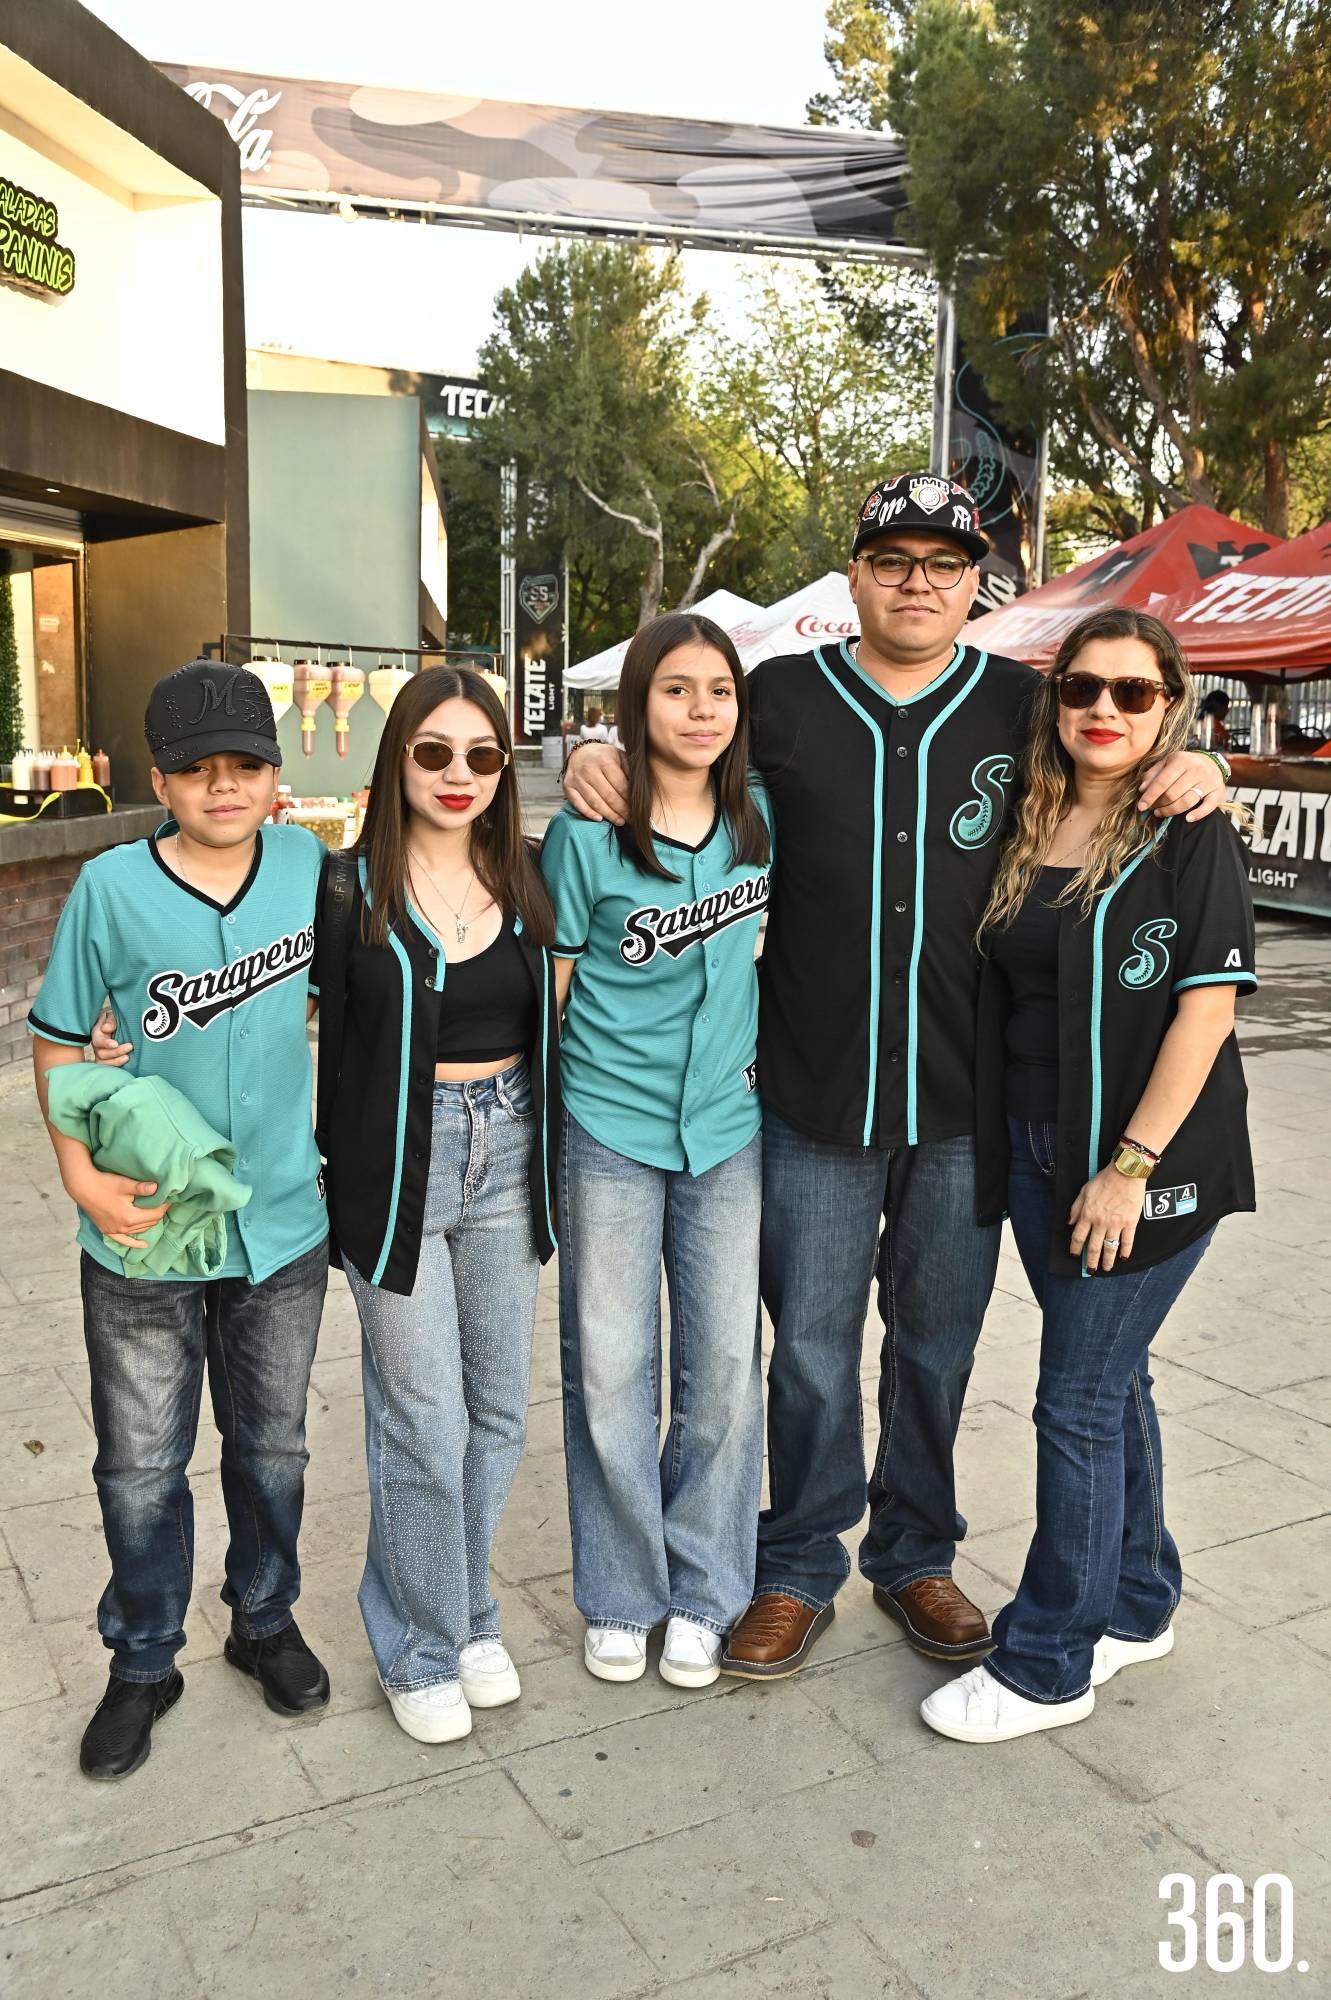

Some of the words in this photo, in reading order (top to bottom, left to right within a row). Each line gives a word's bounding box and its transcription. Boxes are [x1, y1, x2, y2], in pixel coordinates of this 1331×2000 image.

[523, 653, 547, 738] TECATE
[548, 682, 556, 711] LIGHT
[1248, 867, 1298, 889] LIGHT
[142, 923, 315, 1041] Saraperos
[1118, 918, 1178, 990] S
